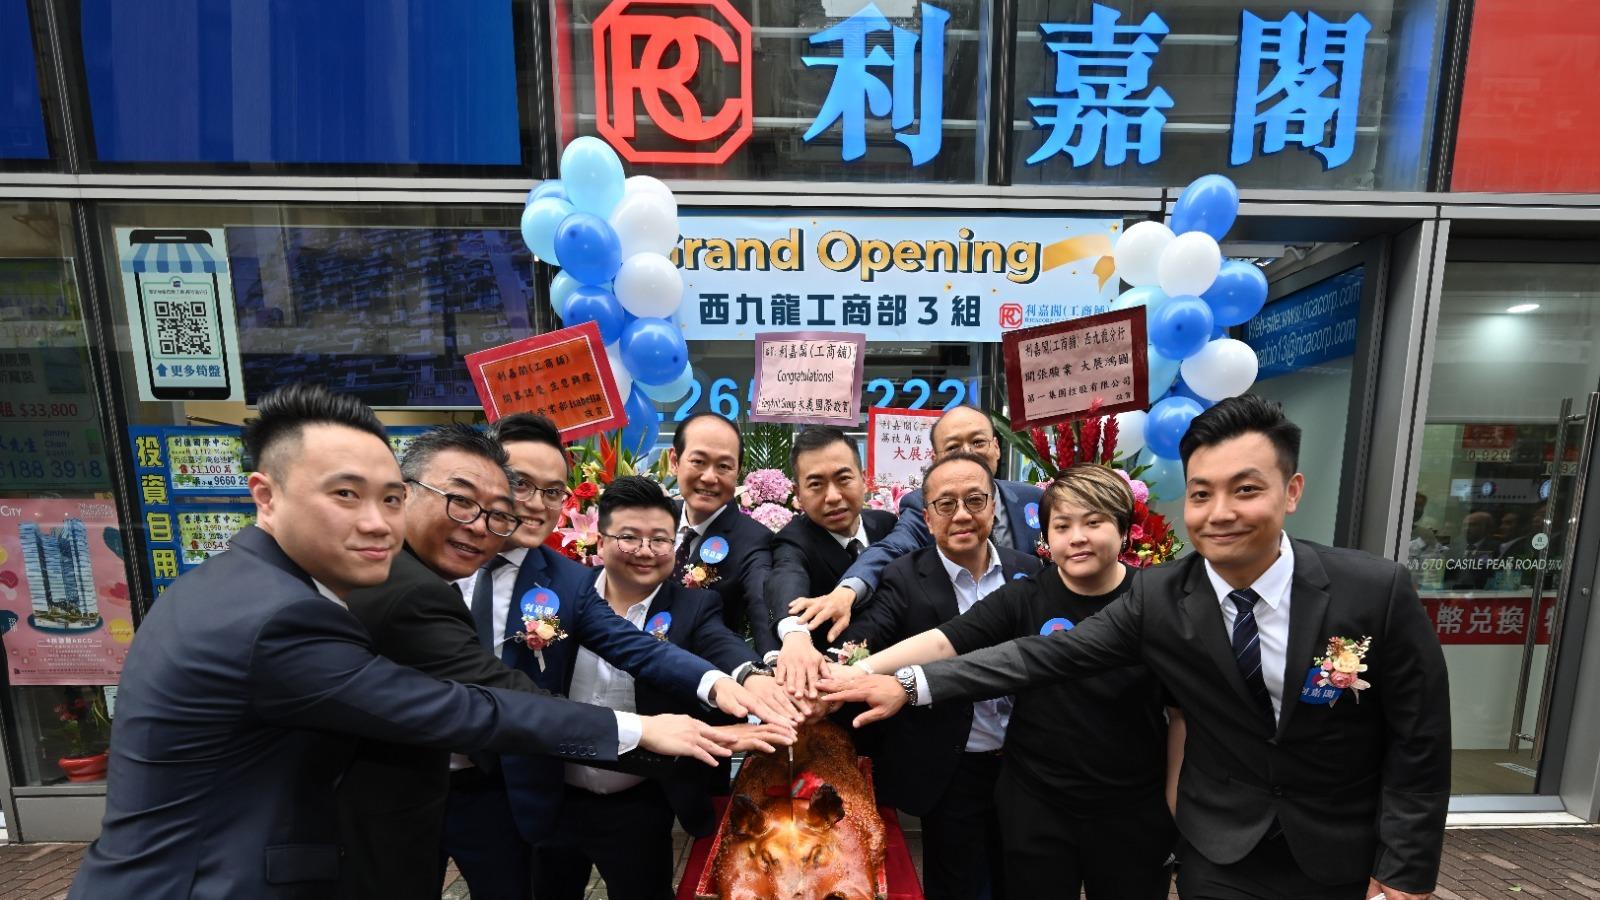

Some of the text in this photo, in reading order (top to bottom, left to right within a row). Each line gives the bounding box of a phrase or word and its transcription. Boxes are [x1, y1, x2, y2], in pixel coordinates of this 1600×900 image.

[801, 2, 1372, 172] 利嘉閣
[817, 228, 1042, 285] Opening
[698, 293, 981, 327] 西九龍工商部3組
[171, 365, 222, 378] 更多筍盤
[777, 369, 834, 385] Congratulations!
[866, 378, 966, 412] 222
[20, 403, 78, 419] $33,800
[880, 419, 935, 432] 利嘉閣(工
[51, 459, 102, 479] 3918
[191, 465, 222, 474] $1,100
[214, 475, 236, 486] 9660
[238, 475, 248, 485] 29
[136, 435, 179, 594] 投資自用
[1421, 558, 1444, 571] 670
[1446, 558, 1483, 571] CASTLE
[1486, 558, 1513, 571] PEAK
[1425, 603, 1524, 634] 幣兌換
